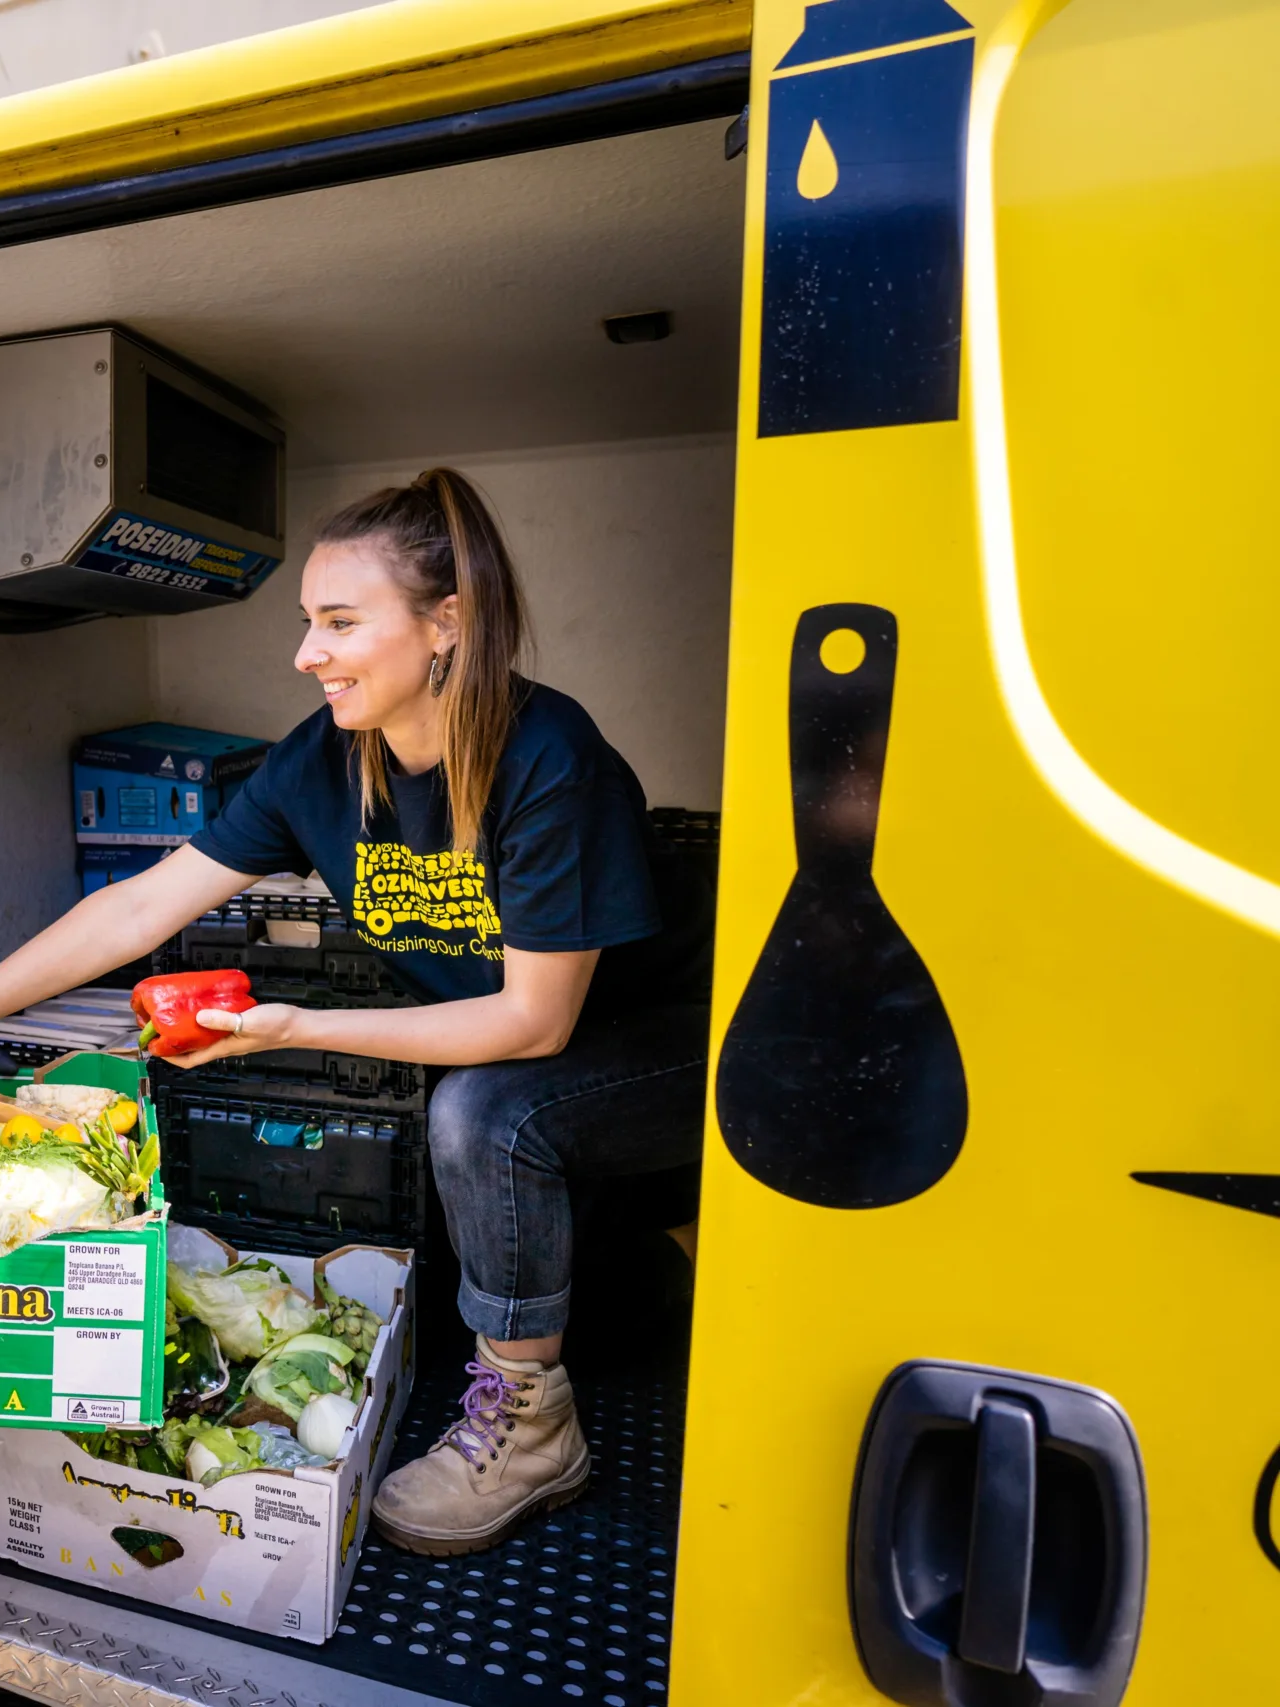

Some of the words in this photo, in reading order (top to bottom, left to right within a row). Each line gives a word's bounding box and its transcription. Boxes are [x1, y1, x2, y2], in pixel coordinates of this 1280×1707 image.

[102, 517, 205, 563] POSEIDON
[125, 562, 170, 583] 9822
[169, 573, 209, 591] 5532
[372, 873, 484, 901] OZHARVEST
[69, 1245, 101, 1254] GROWN
[104, 1247, 120, 1255] FOR
[69, 1262, 94, 1270] Tropicana
[67, 1307, 94, 1316] MEETS
[97, 1308, 123, 1316] ICA-06
[76, 1331, 108, 1339] GROWN
[110, 1332, 121, 1340] BY
[90, 1404, 111, 1412] Grown
[255, 1484, 282, 1496] GROWN
[283, 1490, 296, 1498] FOR
[7, 1496, 26, 1510] 15kg
[28, 1502, 43, 1513] NET
[10, 1508, 40, 1524] WEIGHT
[9, 1518, 34, 1532] CLASS
[6, 1544, 44, 1558] ASSURED
[7, 1538, 44, 1552] QUALITY
